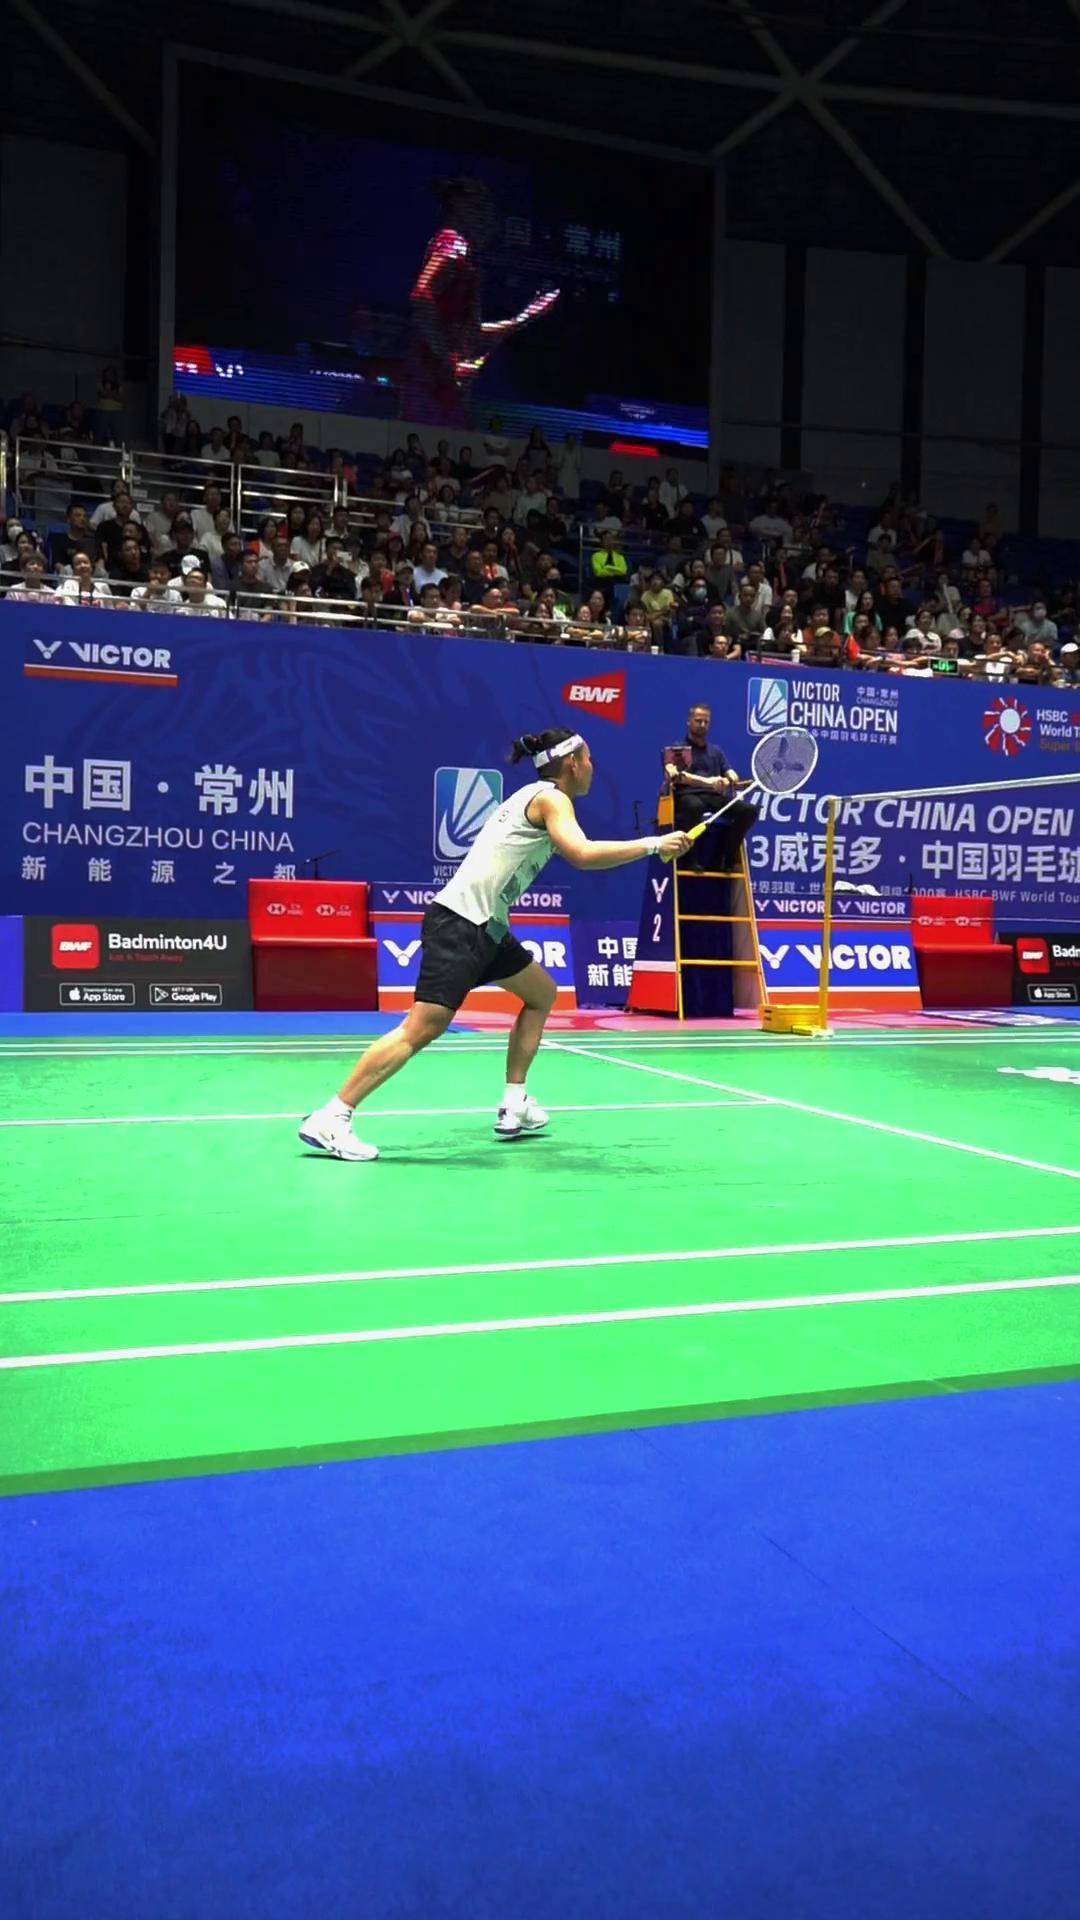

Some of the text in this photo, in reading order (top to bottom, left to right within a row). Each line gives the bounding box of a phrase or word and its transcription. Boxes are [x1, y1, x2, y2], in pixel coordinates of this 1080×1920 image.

[69, 642, 171, 668] VICTOR
[569, 685, 621, 703] BWF
[792, 681, 840, 702] VICTOR
[790, 702, 898, 733] CHINA OPEN
[1036, 709, 1069, 723] HSBC
[1040, 724, 1073, 738] World
[24, 755, 295, 818] 中国·常州
[874, 799, 976, 832] CHINA
[987, 805, 1074, 836] OPEN
[23, 822, 295, 852] CHANGZHOU CHINA
[21, 855, 296, 885] 新能源之都
[991, 889, 1016, 901] BWF
[1021, 891, 1055, 903] World
[773, 899, 825, 914] VICTOR
[855, 901, 906, 915] VICTOR
[652, 913, 662, 942] 2
[108, 933, 228, 950] Badminton4U
[795, 944, 912, 970] VICTOR
[83, 992, 126, 1002] App Store
[171, 992, 217, 1002] Google Play
